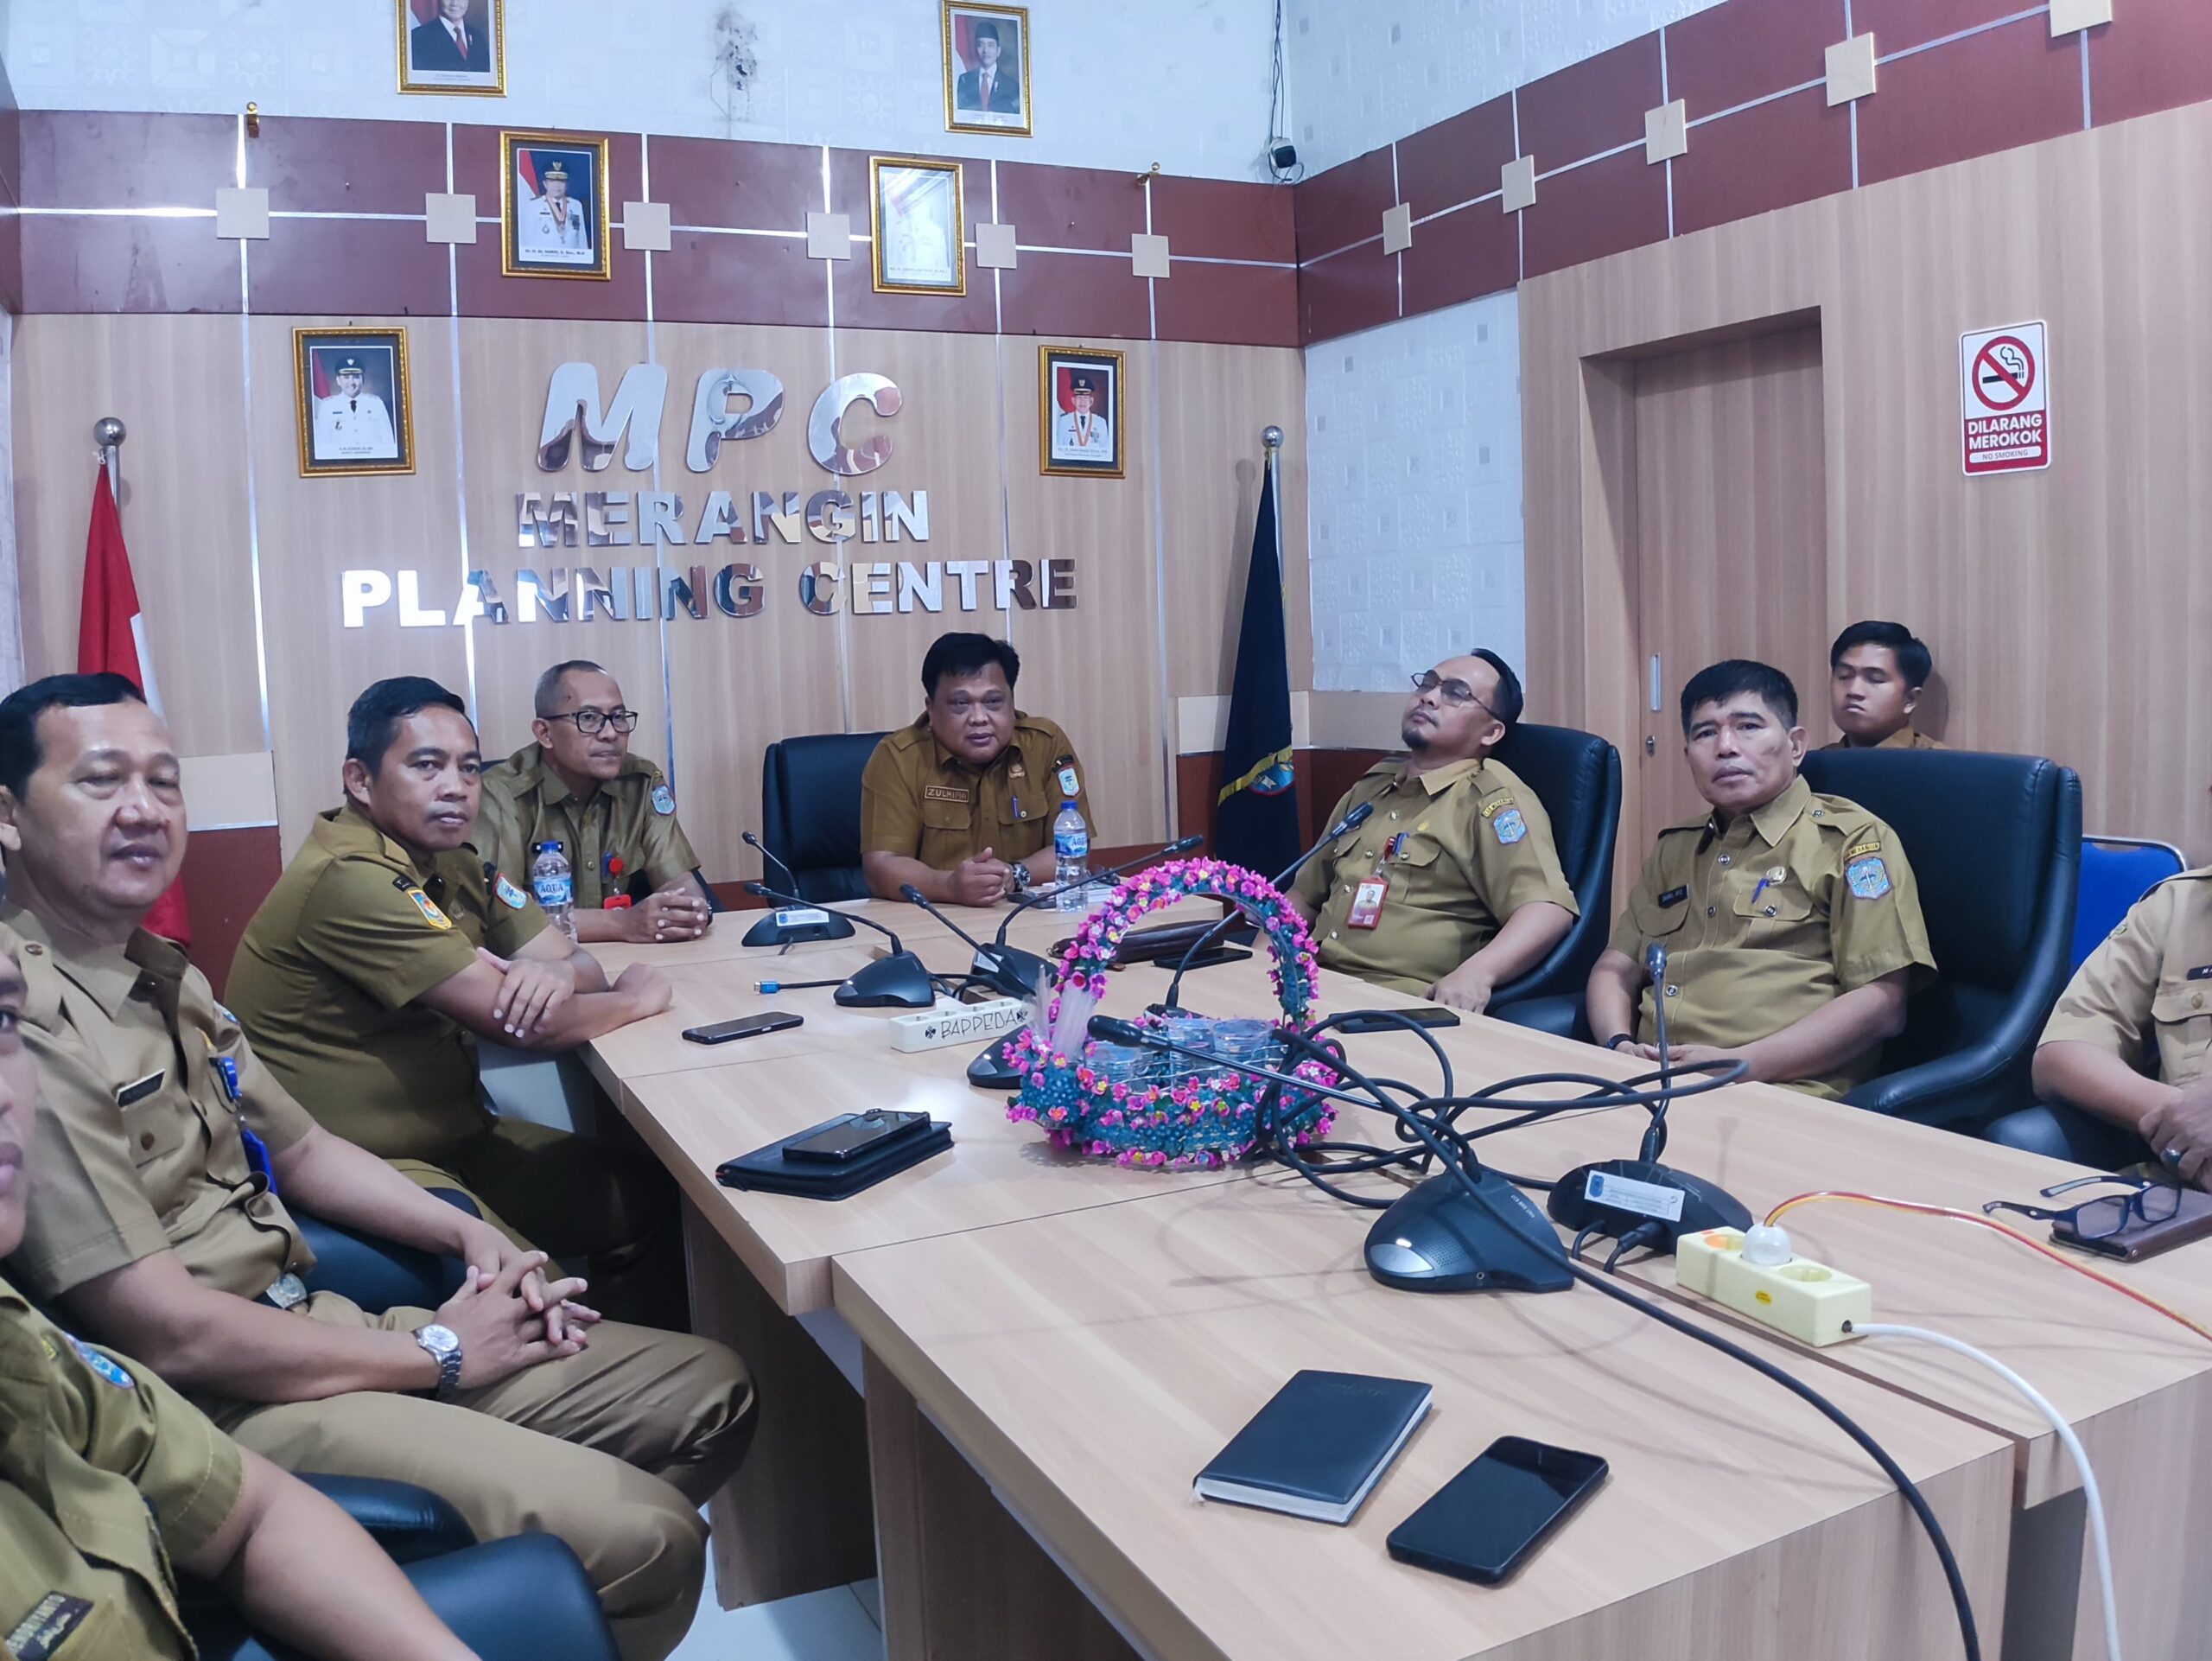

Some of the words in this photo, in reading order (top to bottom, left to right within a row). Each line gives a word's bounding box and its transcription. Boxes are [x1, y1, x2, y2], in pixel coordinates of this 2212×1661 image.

[537, 361, 903, 476] MPC
[1967, 413, 2043, 436] DILARANG
[1968, 429, 2043, 450] MEROKOK
[1994, 449, 2029, 459] SMOKING
[516, 489, 931, 547] MERANGIN
[341, 563, 766, 628] PLANNING
[799, 558, 1078, 616] CENTRE
[540, 882, 564, 894] AQUA
[941, 1010, 1017, 1039] BAPPEDA
